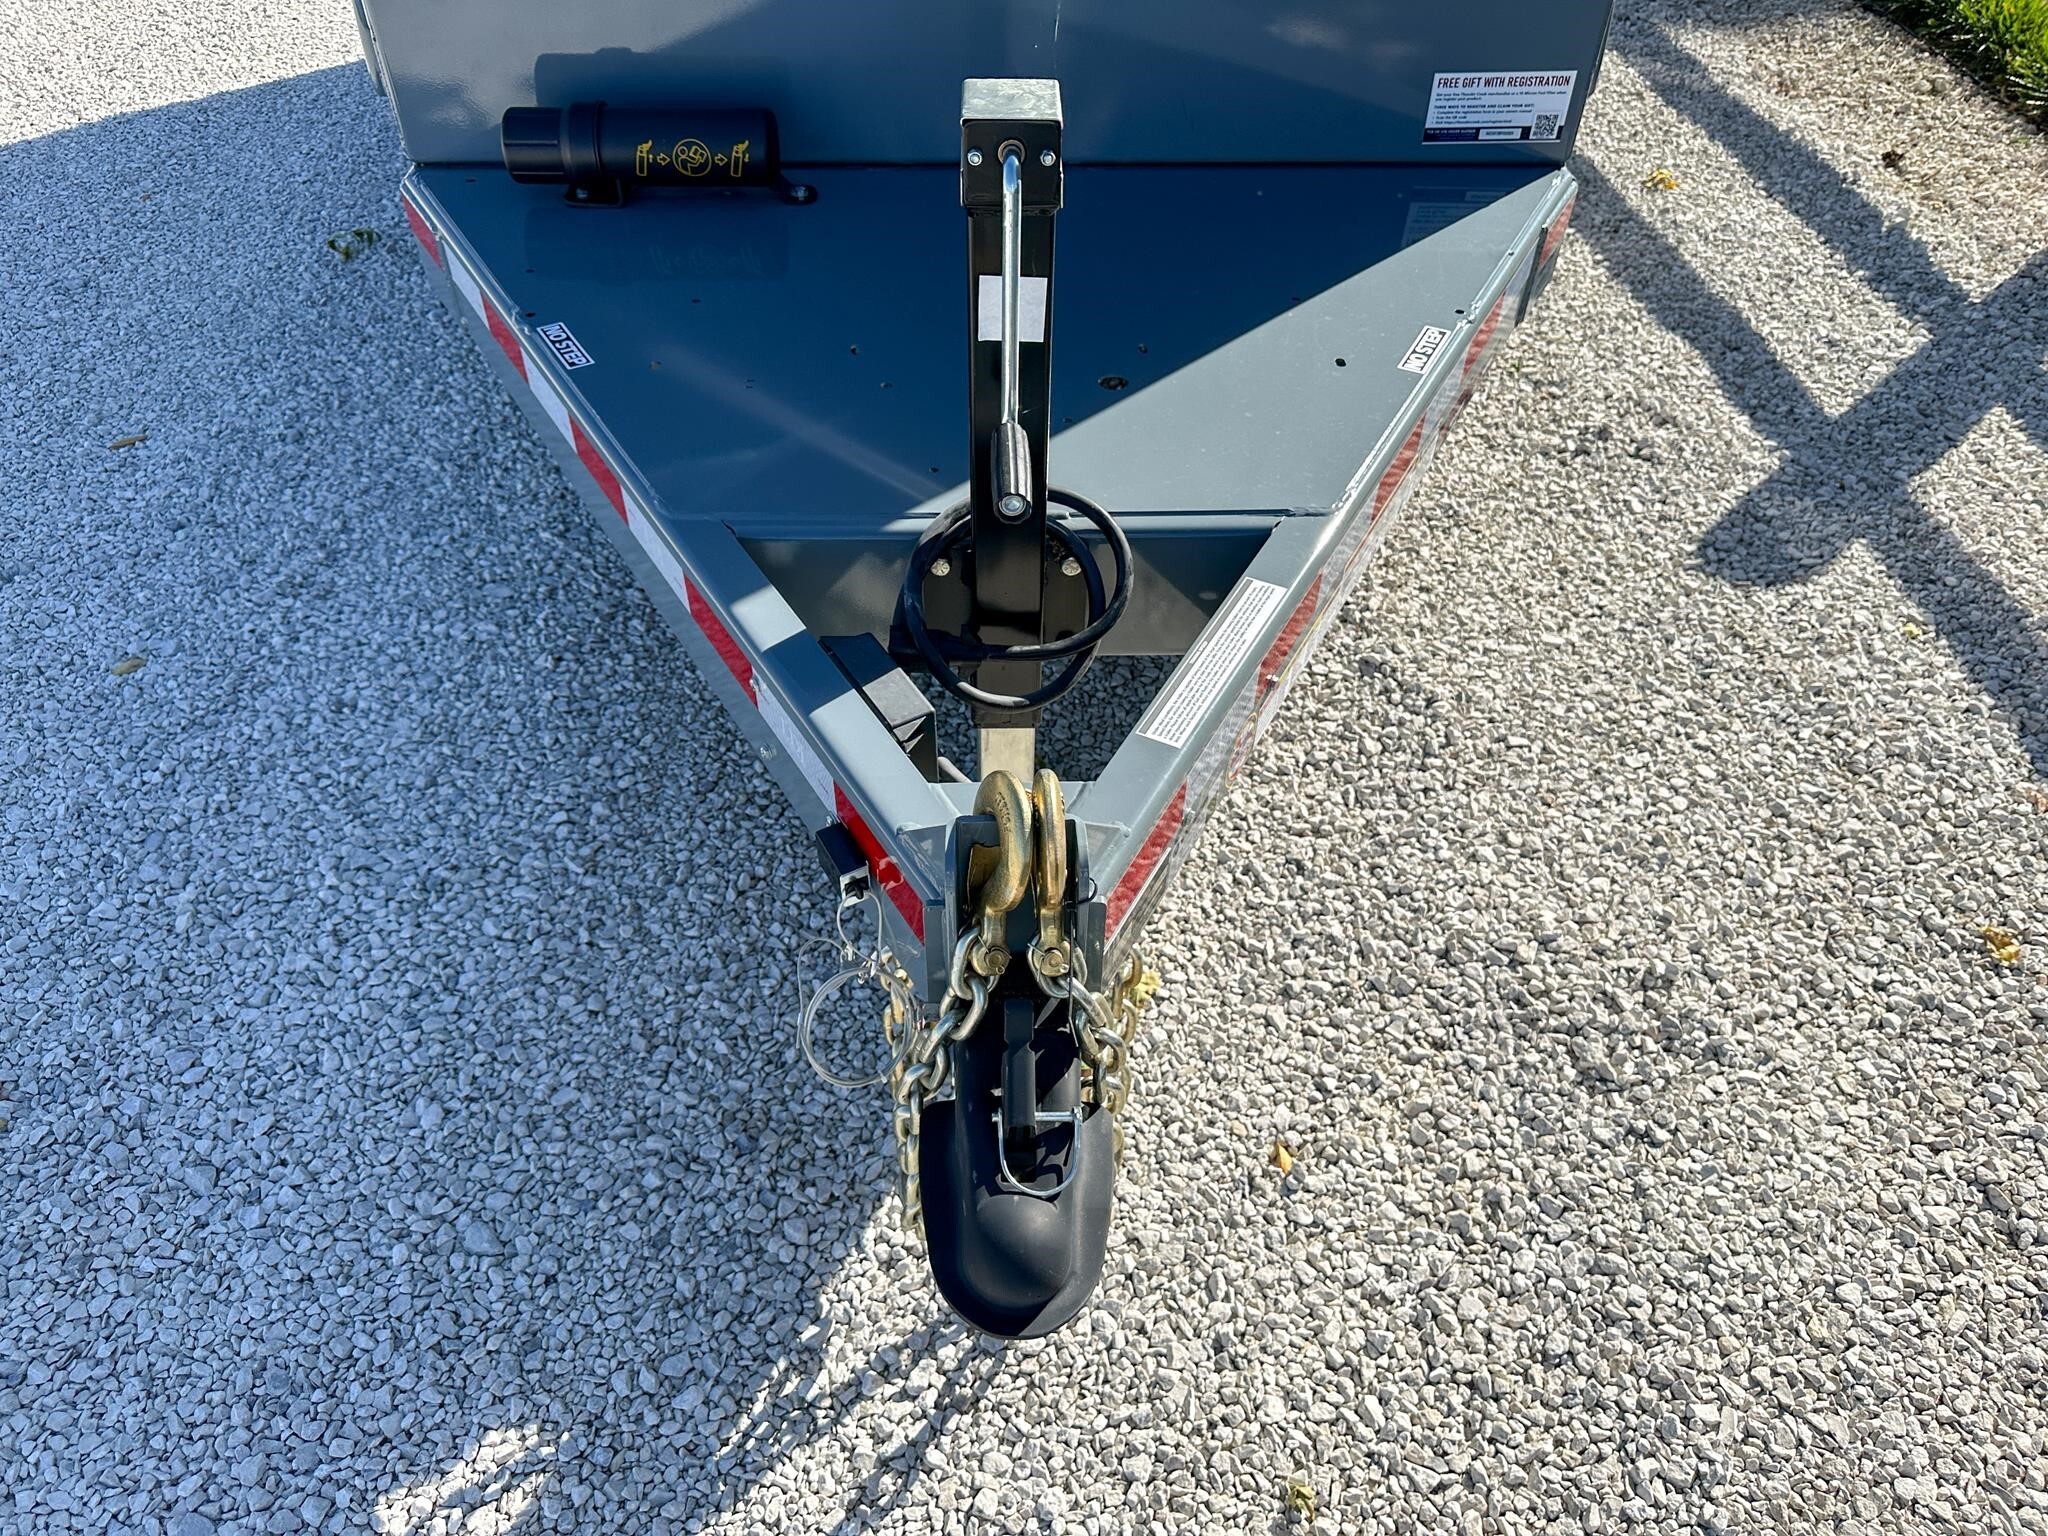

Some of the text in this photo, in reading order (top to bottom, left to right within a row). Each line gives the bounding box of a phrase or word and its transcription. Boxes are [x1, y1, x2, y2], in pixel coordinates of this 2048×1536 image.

[1437, 75, 1571, 89] FREE GIFT WITH REGISTRATION
[543, 324, 587, 365] NO STEP
[1403, 328, 1443, 371] NO STEP
